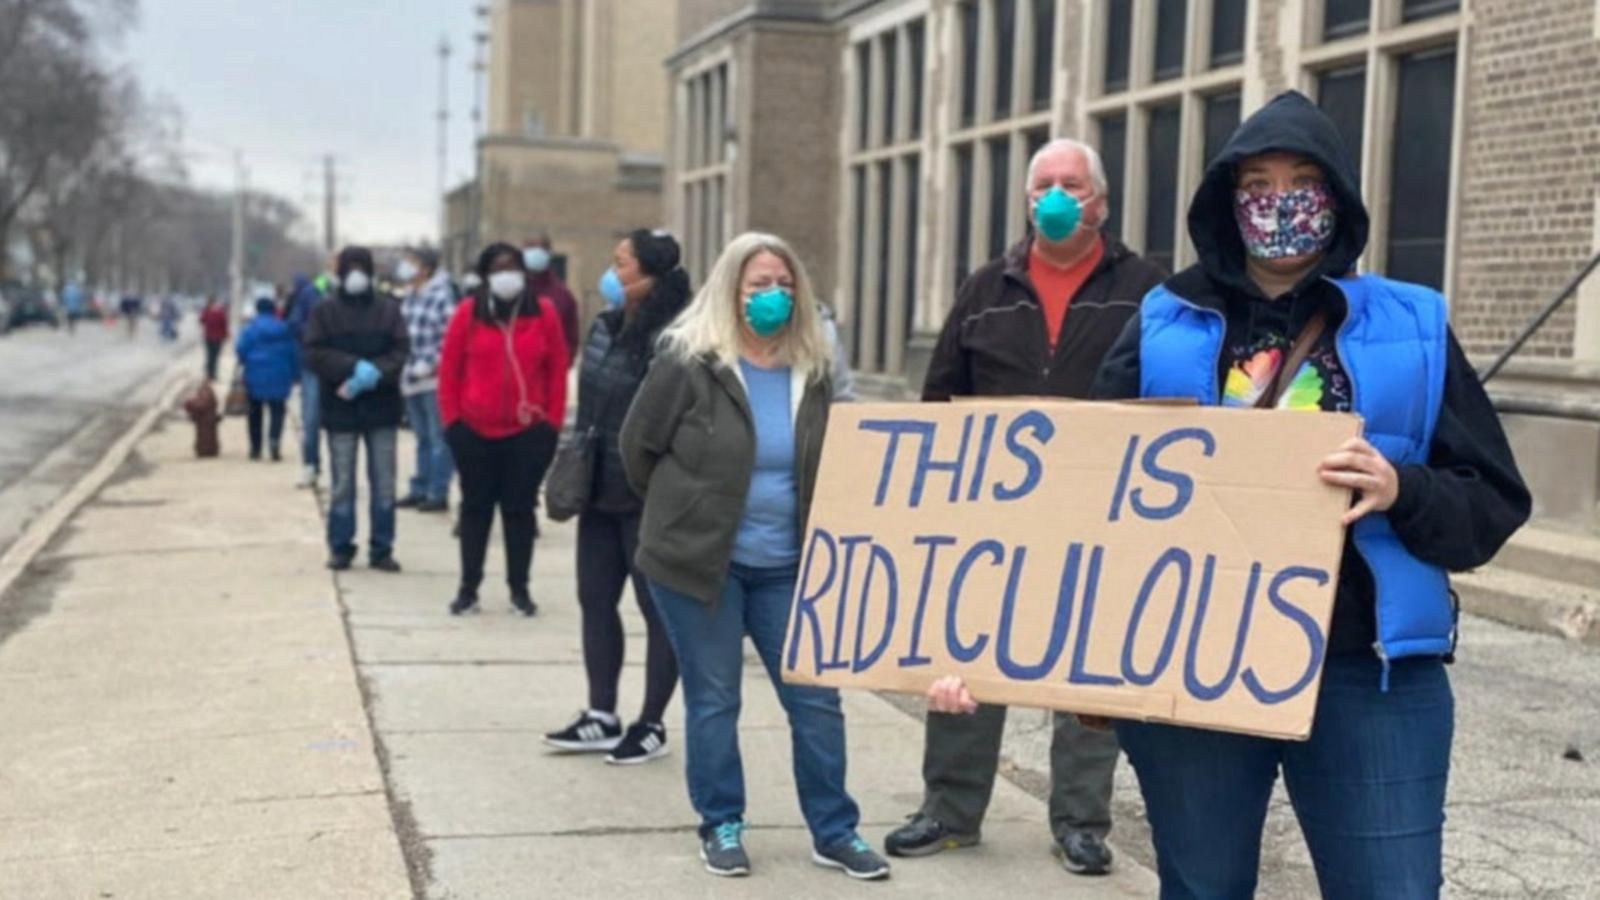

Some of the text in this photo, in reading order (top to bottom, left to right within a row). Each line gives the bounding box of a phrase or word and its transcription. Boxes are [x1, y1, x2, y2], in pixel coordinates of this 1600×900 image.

[858, 410, 1216, 522] THIS IS
[787, 528, 1330, 705] RIDICULOUS
